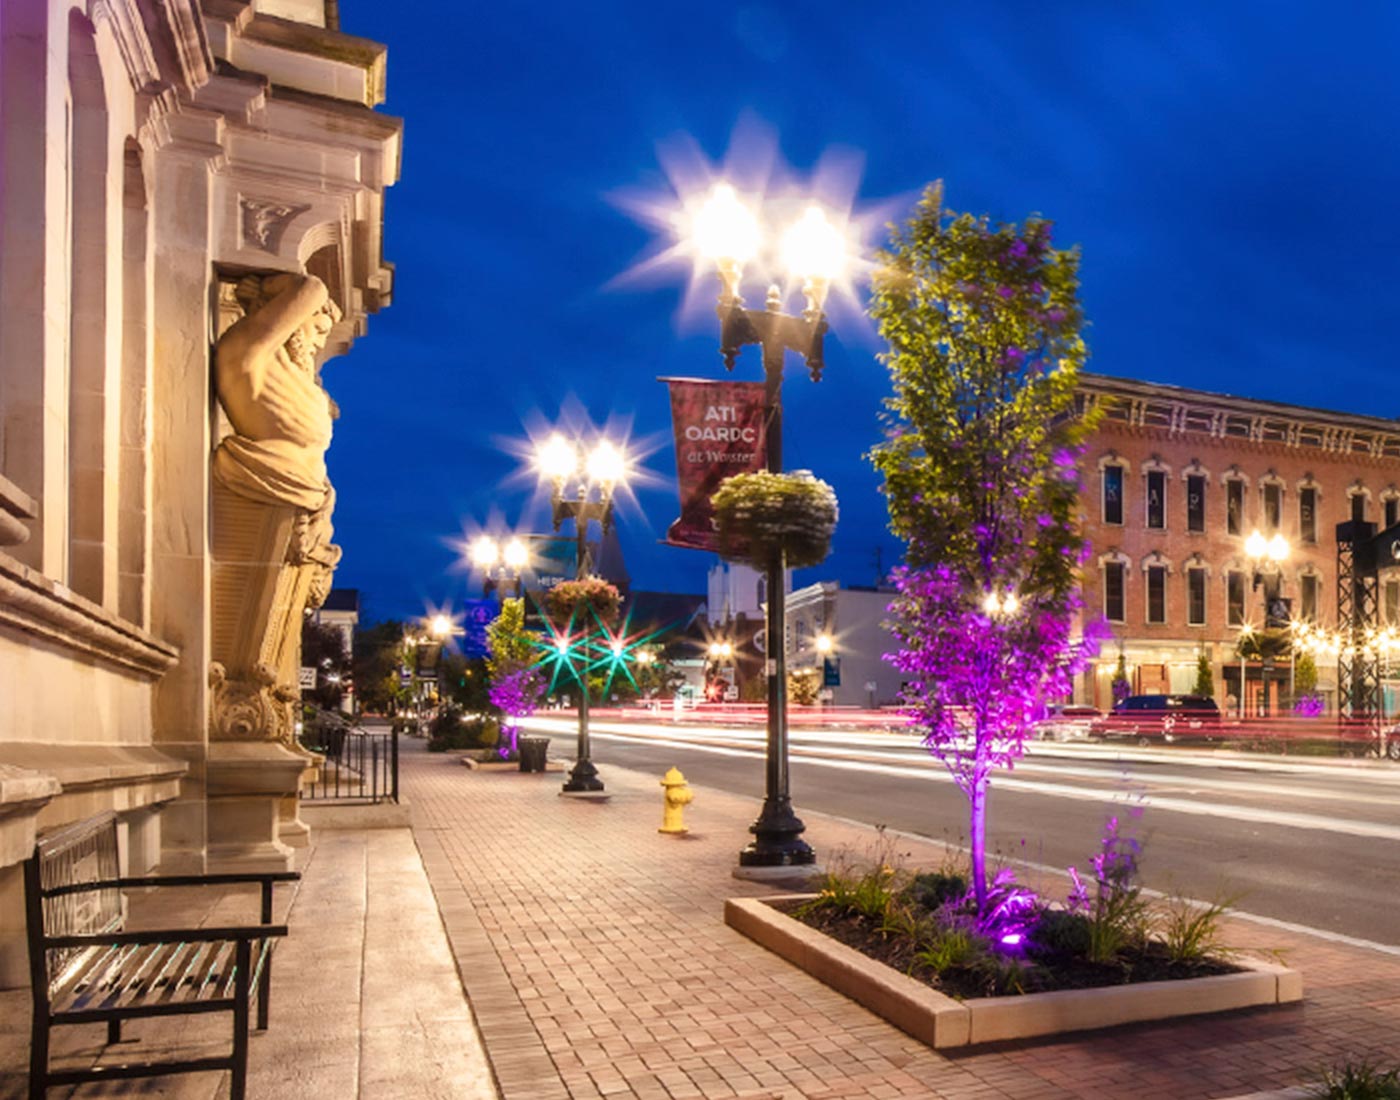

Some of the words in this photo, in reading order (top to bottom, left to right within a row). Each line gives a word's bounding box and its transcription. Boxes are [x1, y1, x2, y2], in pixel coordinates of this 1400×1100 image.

[705, 405, 737, 422] ATI
[685, 425, 755, 444] OARDC
[687, 451, 703, 463] at
